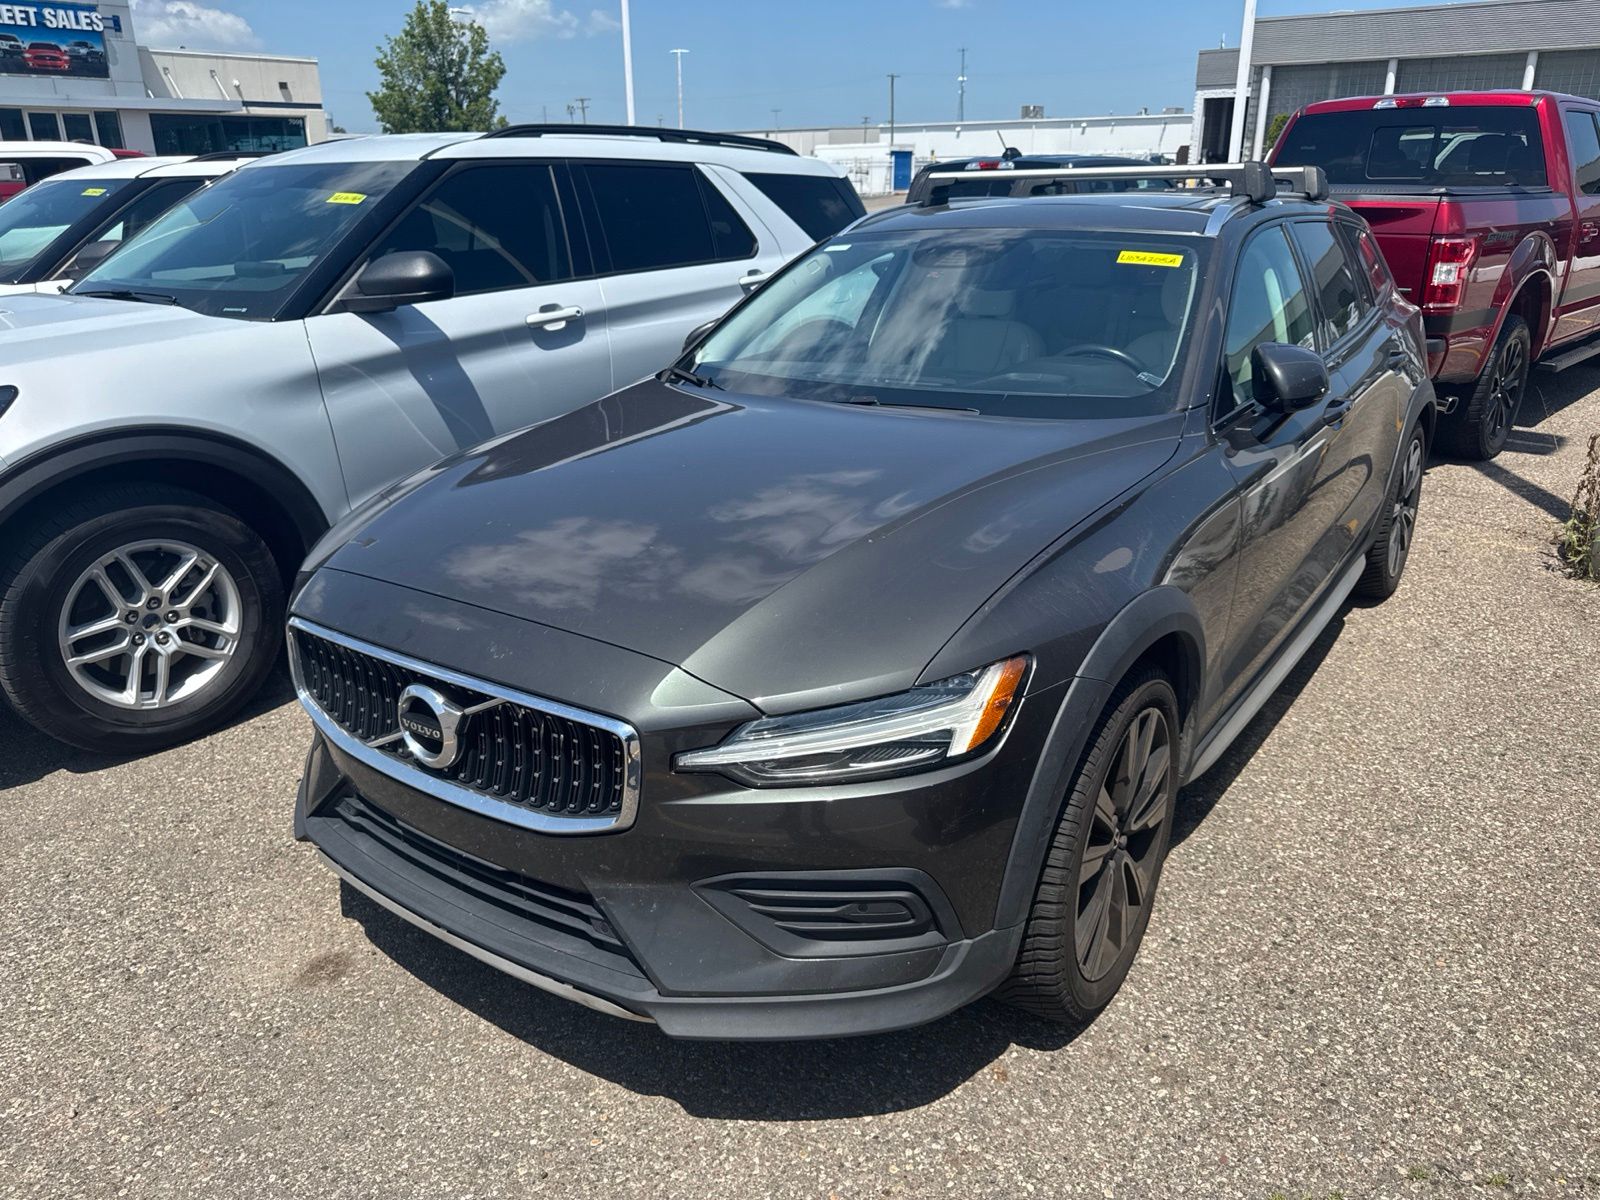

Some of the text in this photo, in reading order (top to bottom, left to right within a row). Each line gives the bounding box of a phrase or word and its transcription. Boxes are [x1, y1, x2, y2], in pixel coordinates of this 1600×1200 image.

[0, 4, 104, 32] EET SALES
[402, 718, 440, 738] VOLVO
